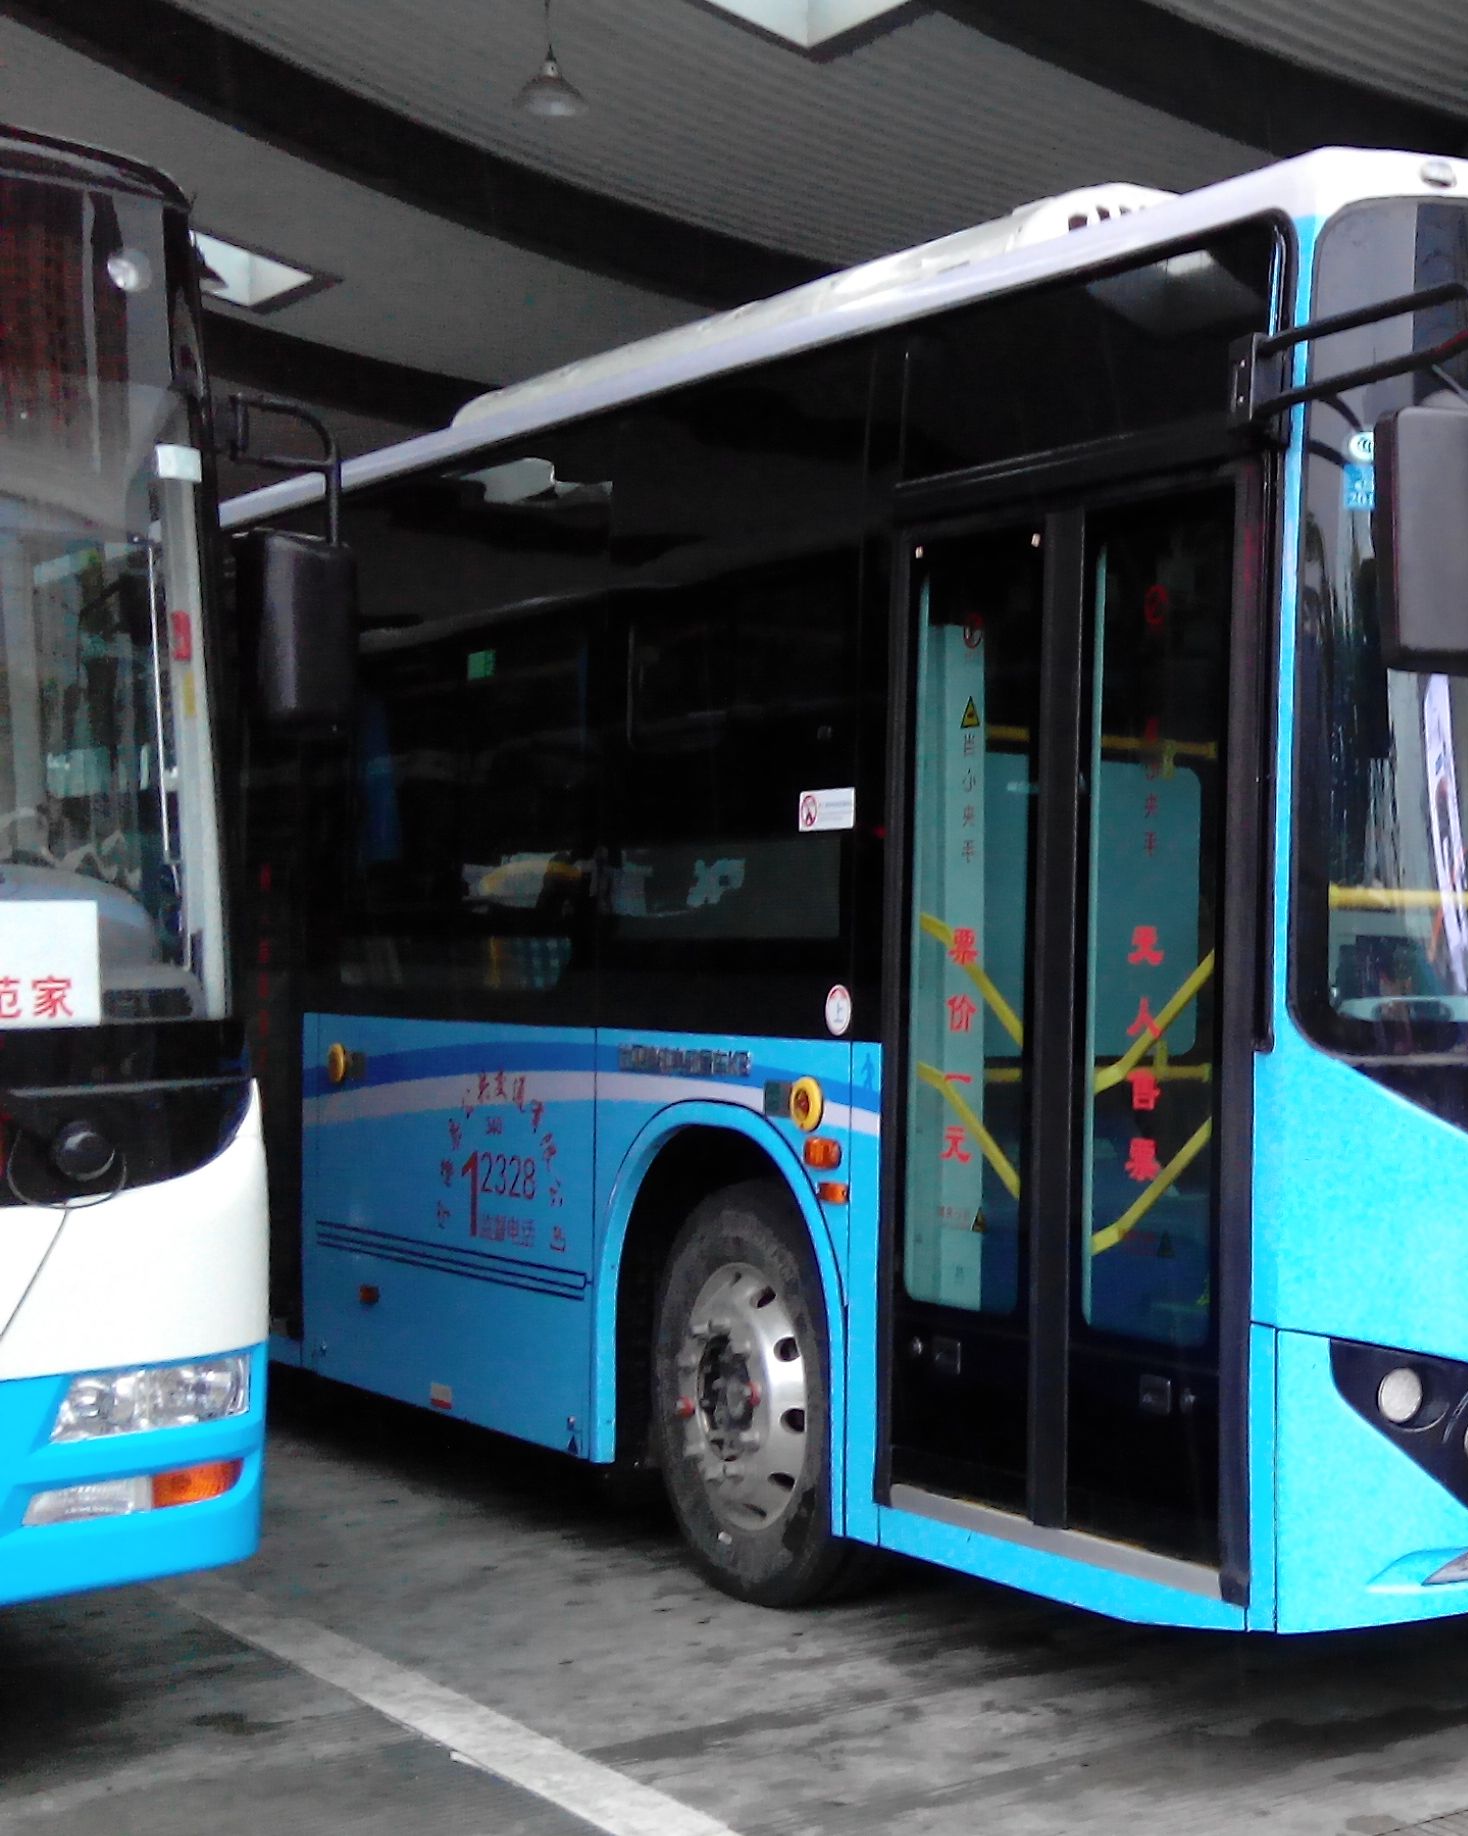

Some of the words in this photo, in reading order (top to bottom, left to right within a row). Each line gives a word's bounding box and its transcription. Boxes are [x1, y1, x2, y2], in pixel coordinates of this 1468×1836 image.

[941, 928, 977, 1163] 票价一元
[1126, 926, 1164, 1181] 无人售票
[462, 1151, 536, 1237] 12328
